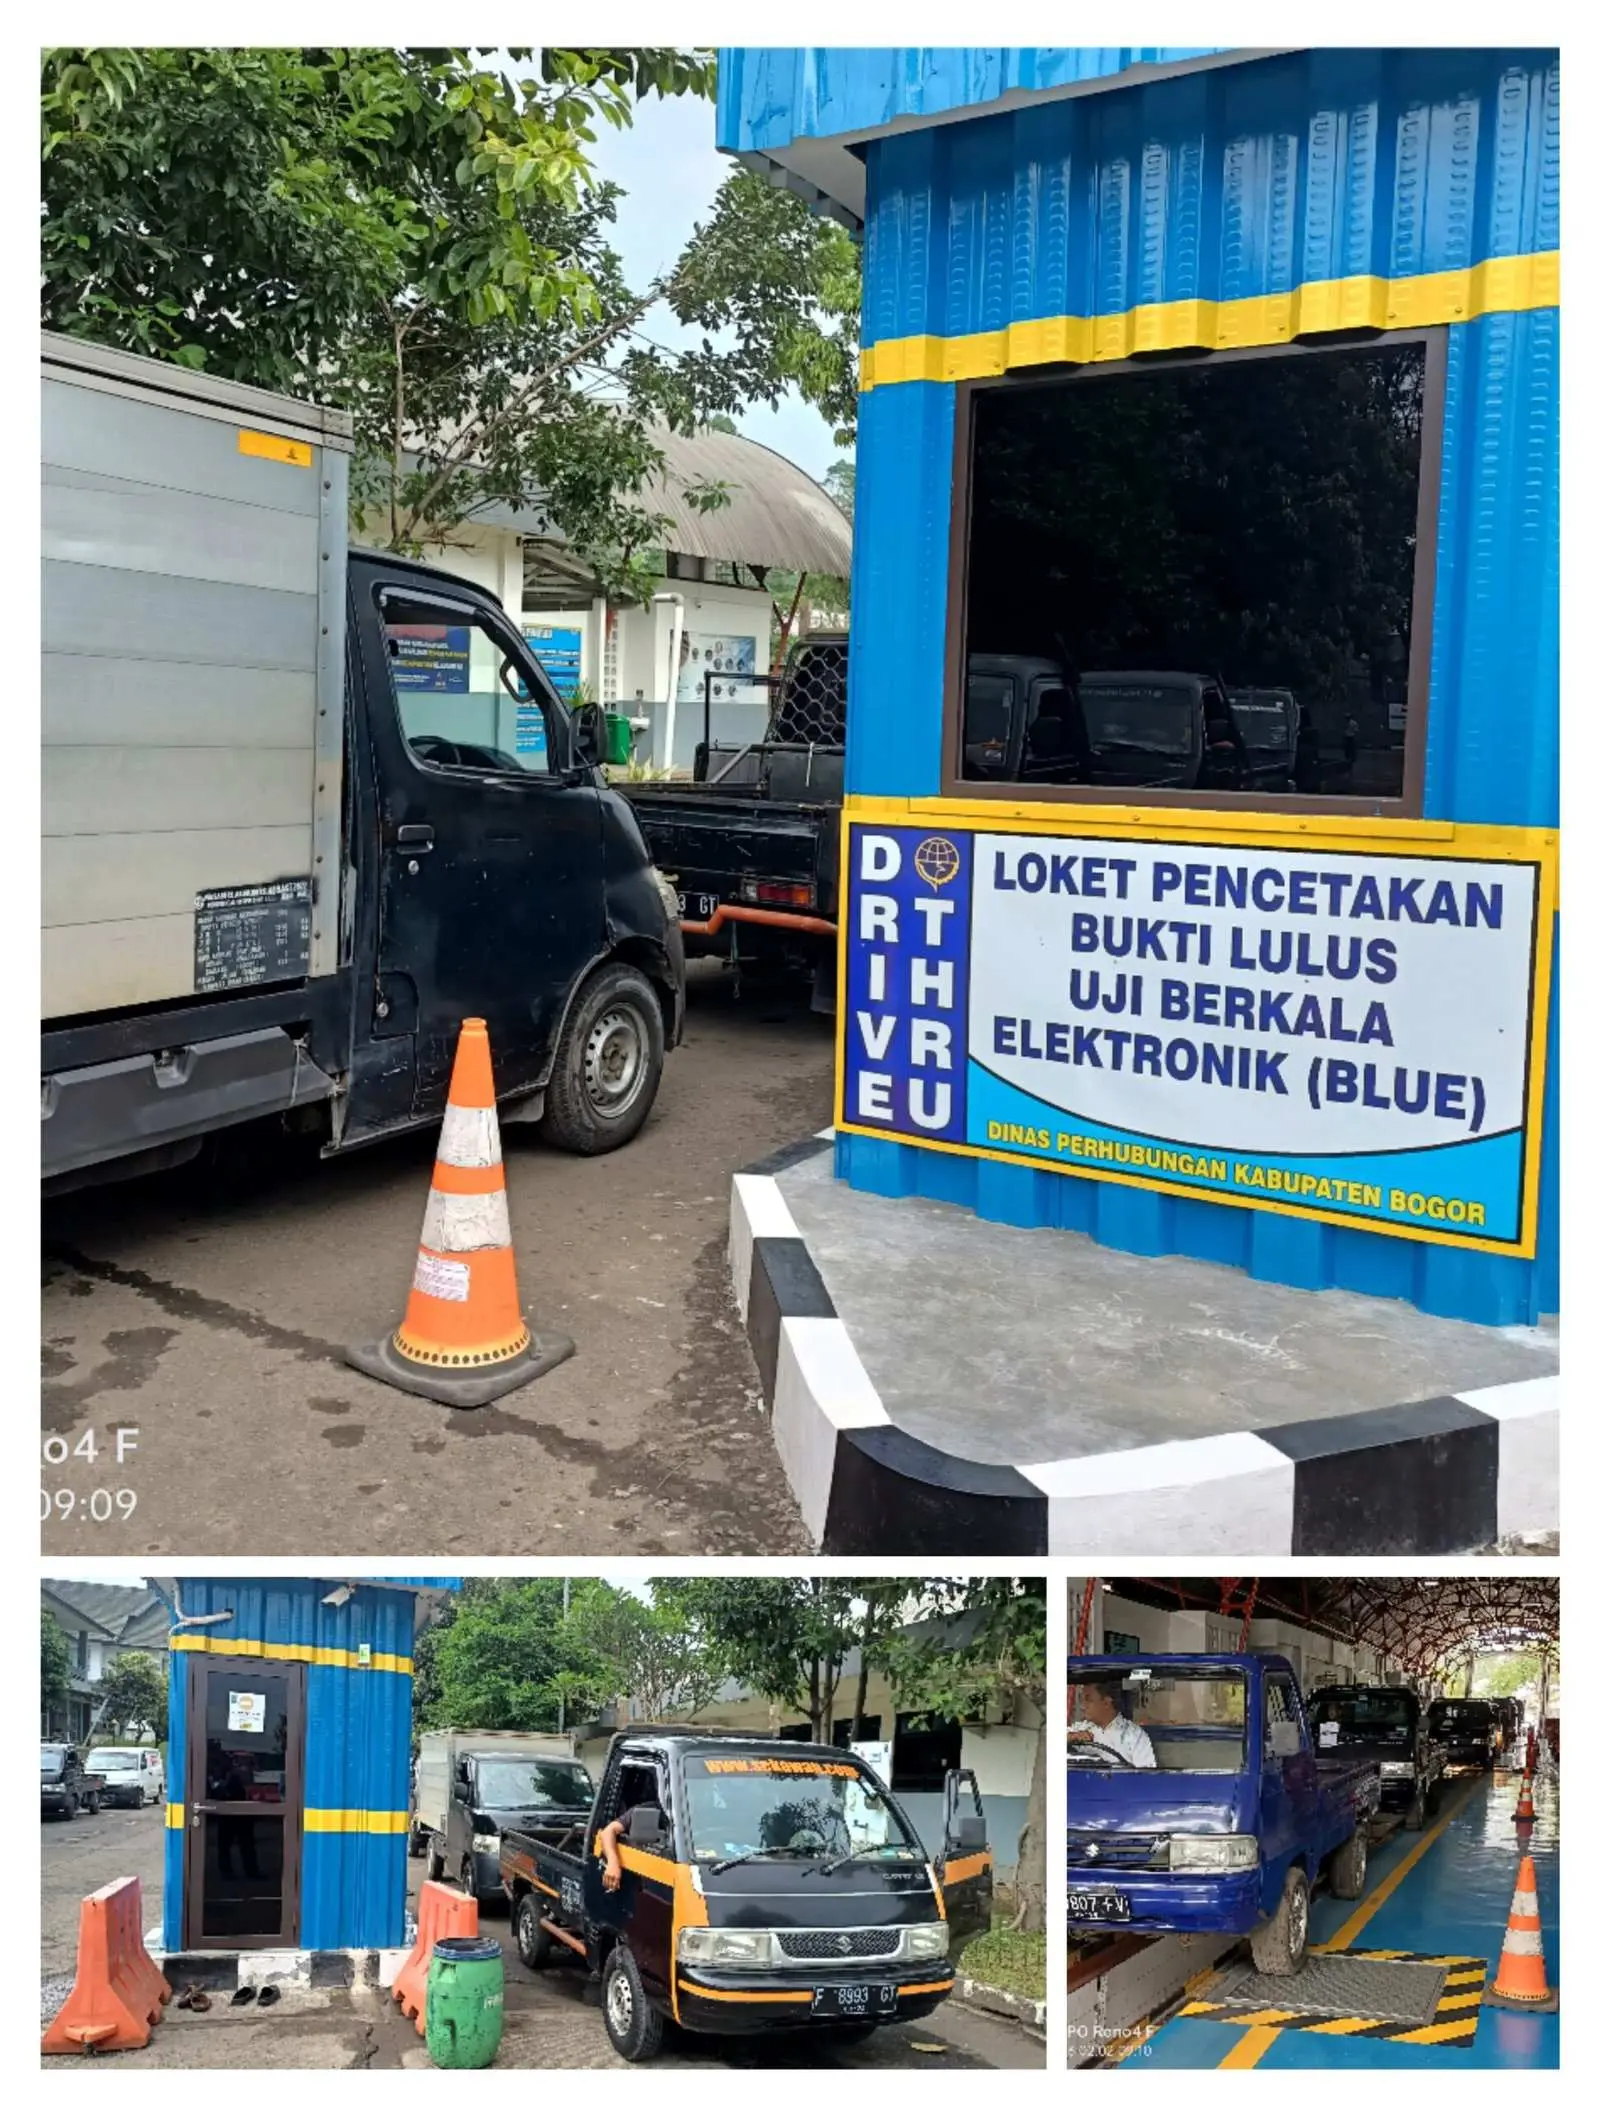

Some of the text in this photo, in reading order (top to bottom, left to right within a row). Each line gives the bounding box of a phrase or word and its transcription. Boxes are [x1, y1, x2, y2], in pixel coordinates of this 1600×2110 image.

[700, 895, 716, 915] GT
[993, 850, 1504, 930] LOKET PENCETAKAN
[857, 834, 901, 1121] DRIVE
[1071, 912, 1398, 985] BUKTI LULUS
[909, 897, 954, 1130] THRU
[1069, 968, 1395, 1048] UJI BERKALA
[993, 1015, 1486, 1134] ELEKTRONIK (BLUE)
[987, 1120, 1486, 1226] DINAS PERHUBUNGAN KABUPATEN BOGOR
[814, 1986, 896, 2007] F 8993 GT
